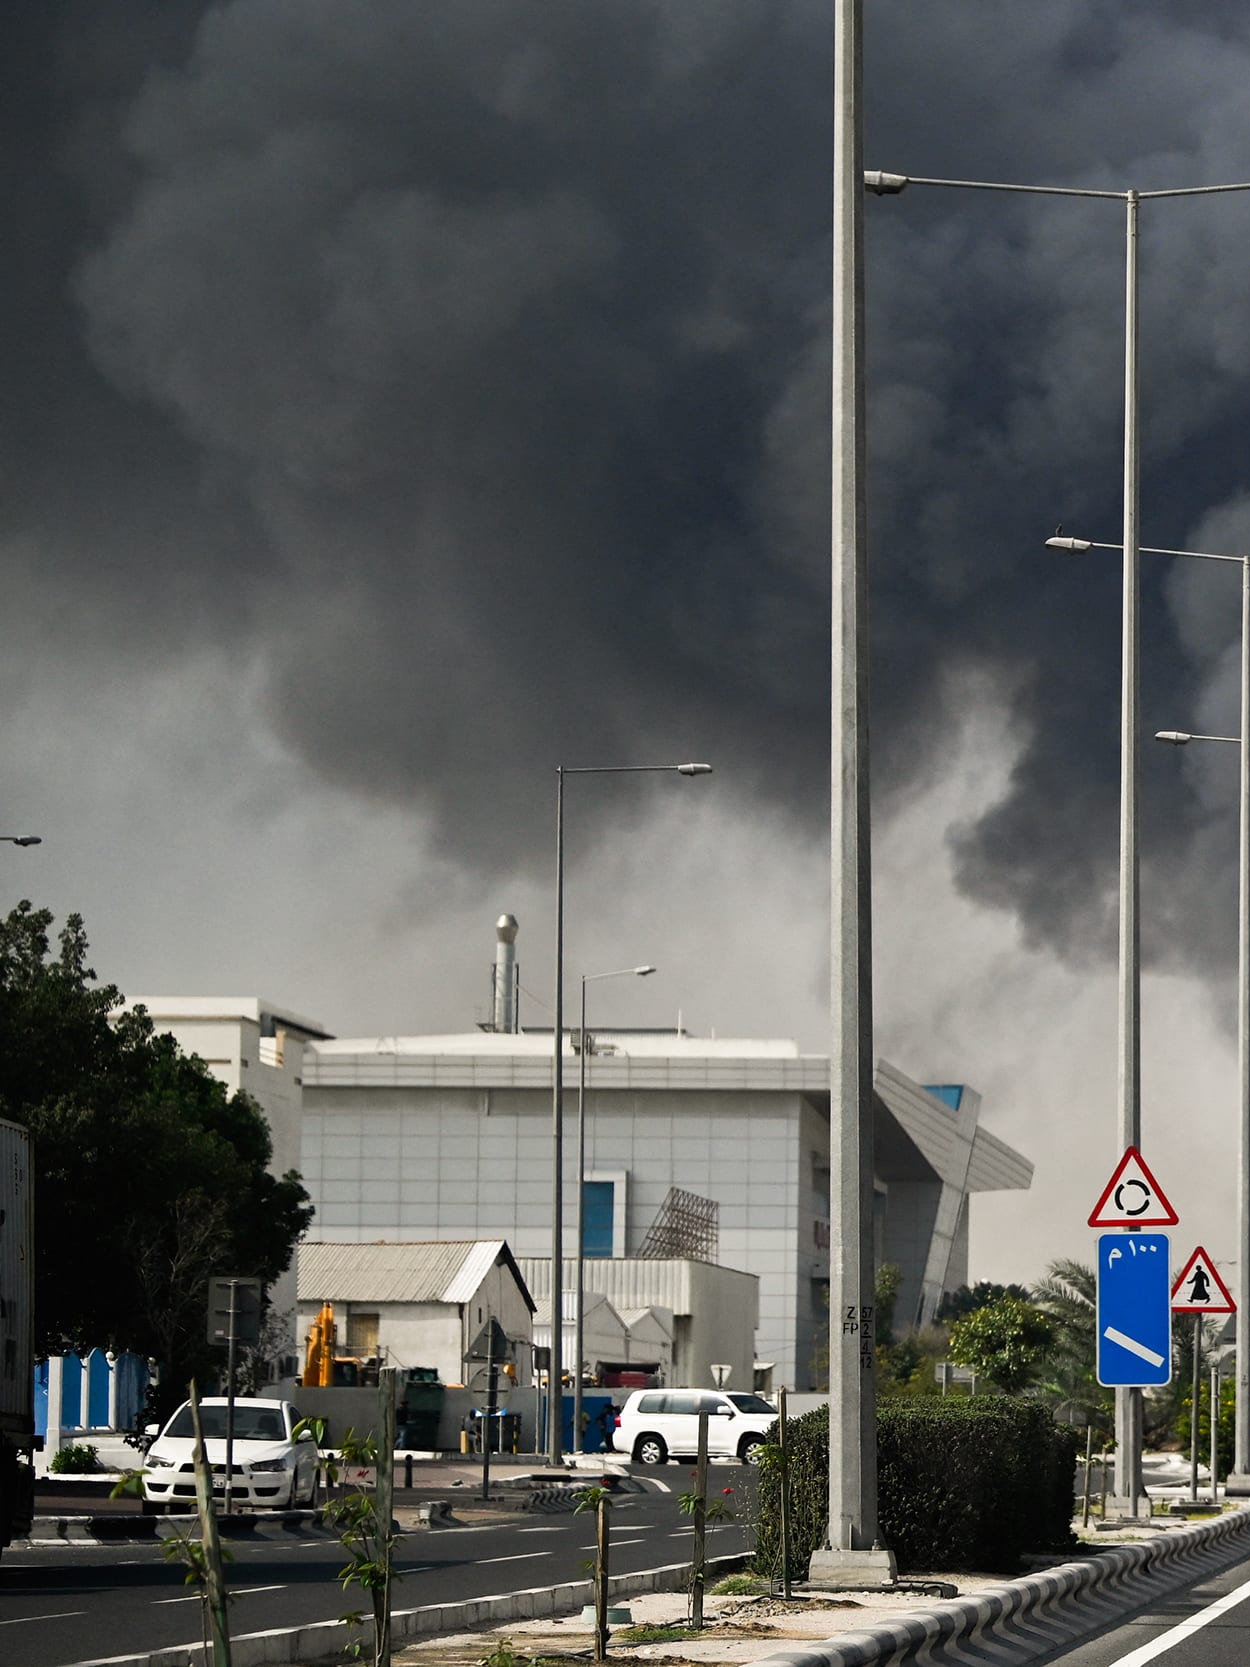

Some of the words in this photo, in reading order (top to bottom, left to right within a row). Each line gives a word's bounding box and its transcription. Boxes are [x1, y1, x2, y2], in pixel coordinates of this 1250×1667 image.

[1108, 1247, 1122, 1270] م
[847, 1306, 856, 1319] Z
[843, 1322, 859, 1335] FP
[863, 1322, 870, 1335] 2
